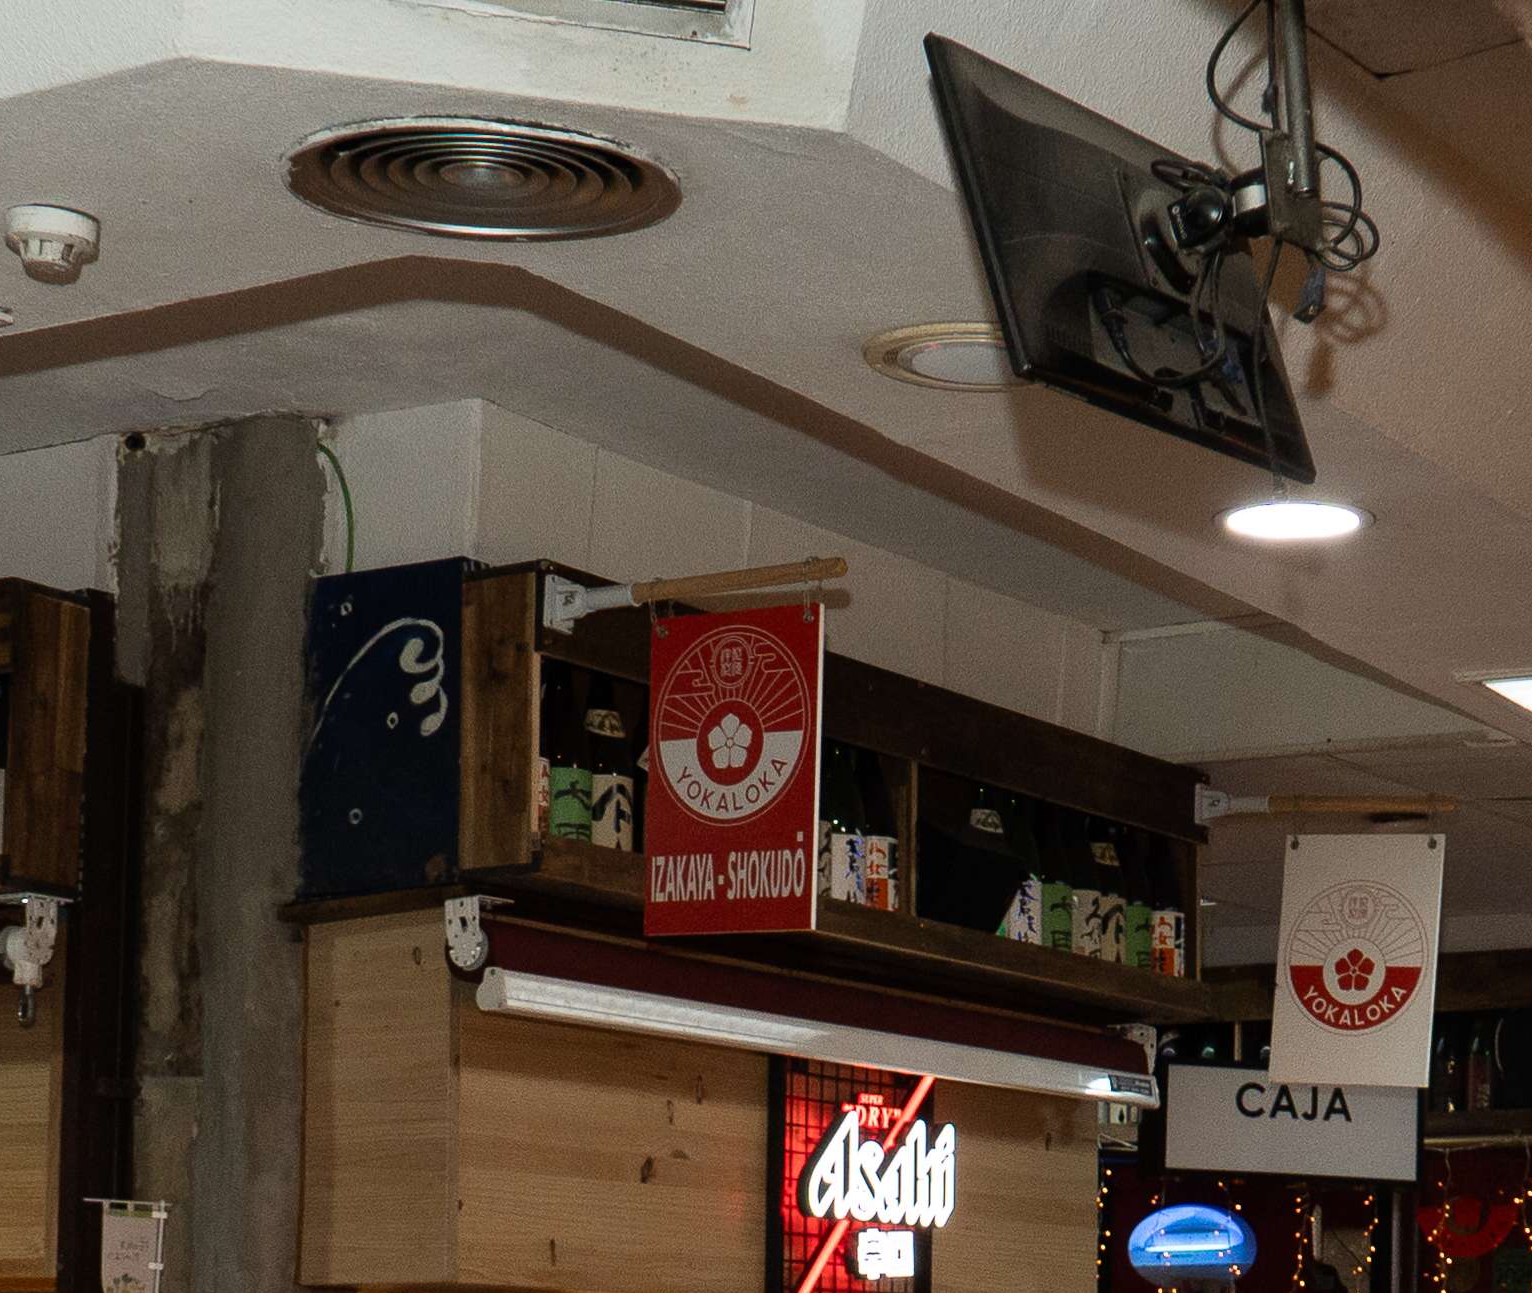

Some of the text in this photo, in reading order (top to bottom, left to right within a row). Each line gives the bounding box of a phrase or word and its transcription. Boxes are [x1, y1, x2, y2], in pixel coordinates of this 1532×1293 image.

[677, 759, 787, 812] YOKALOKA
[651, 853, 715, 903] IZAKAYA
[1303, 985, 1407, 1026] YOKALOKA
[1235, 1082, 1352, 1122] CAJA
[808, 1110, 956, 1228] Asahi
